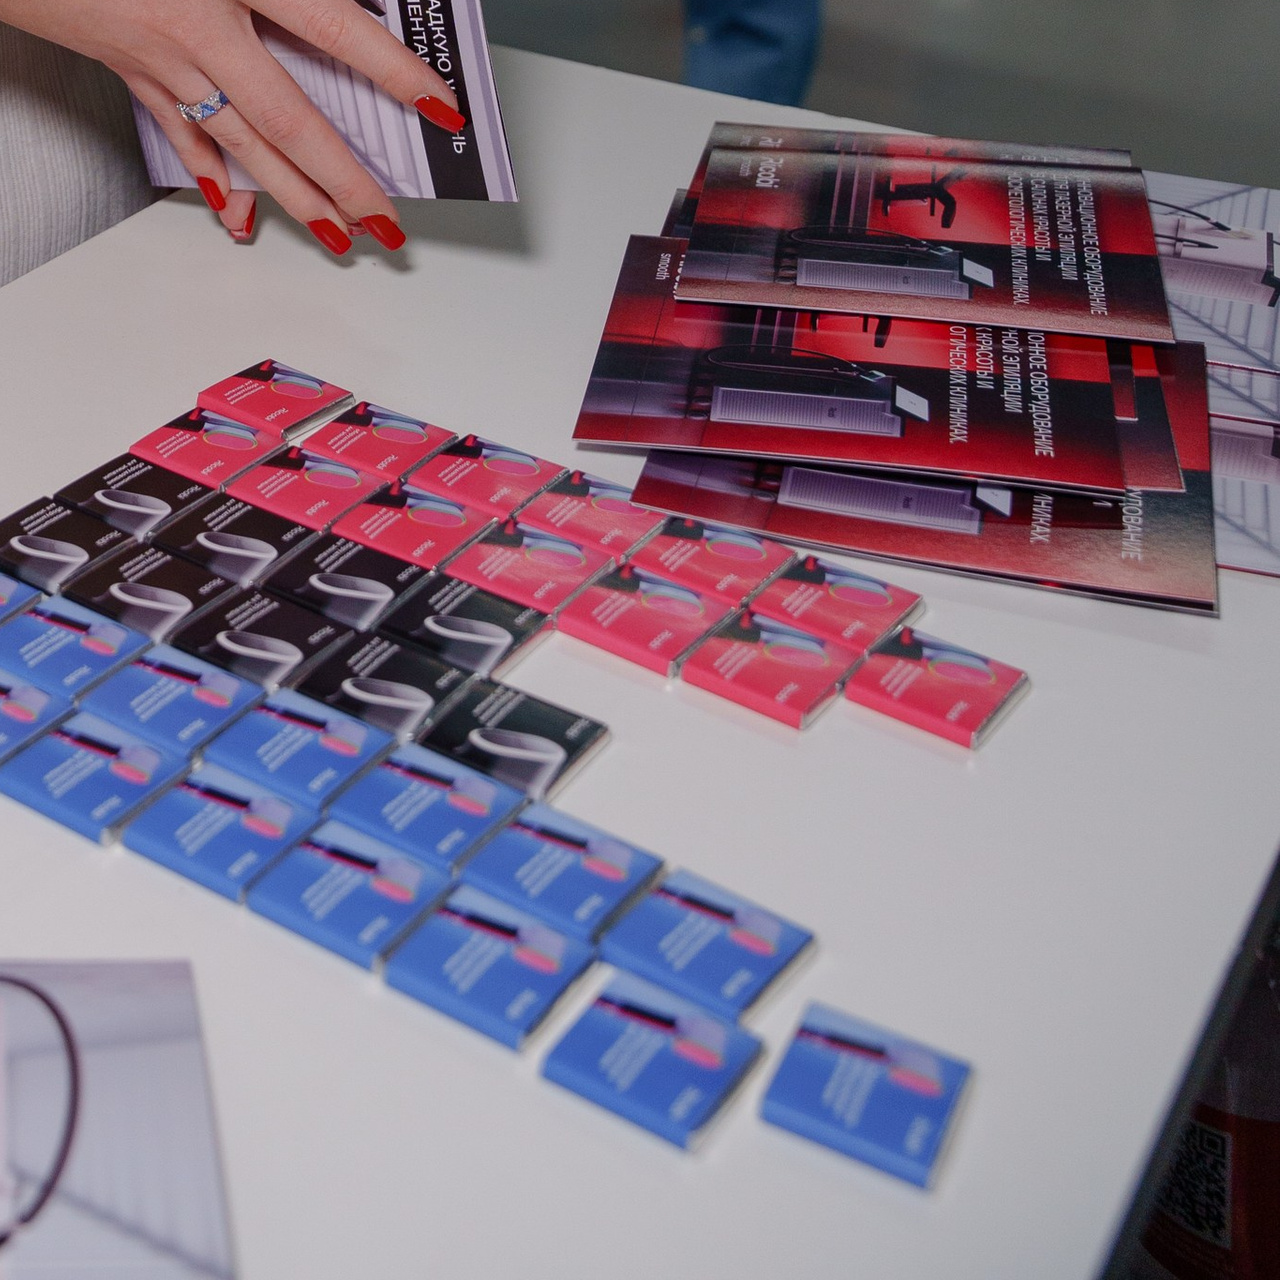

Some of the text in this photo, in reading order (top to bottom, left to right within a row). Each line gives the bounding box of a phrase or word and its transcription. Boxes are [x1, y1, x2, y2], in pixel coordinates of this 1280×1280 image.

[755, 156, 783, 188] Ricobi
[1030, 179, 1049, 214] САЛОНАХ
[1054, 190, 1076, 233] ЛАЗЕРНОЙ
[1033, 215, 1050, 253] КРАСОТЫ
[1055, 233, 1078, 280] ЭПИЛЯЦИИ
[655, 252, 672, 279] smooth
[1011, 259, 1030, 305] КЛИНИКАХ.
[1083, 247, 1108, 315] ОБОРУДОВАНИЕ
[975, 332, 995, 389] КРАСОТЫ И
[1000, 355, 1023, 413] ЭПИЛЯЦИИ
[949, 386, 968, 444] КЛИНИКАХ.
[1027, 331, 1055, 457] ОННОЕ ОБОРУДОВАНИЕ
[1120, 489, 1143, 560] УДОВАНИЕ
